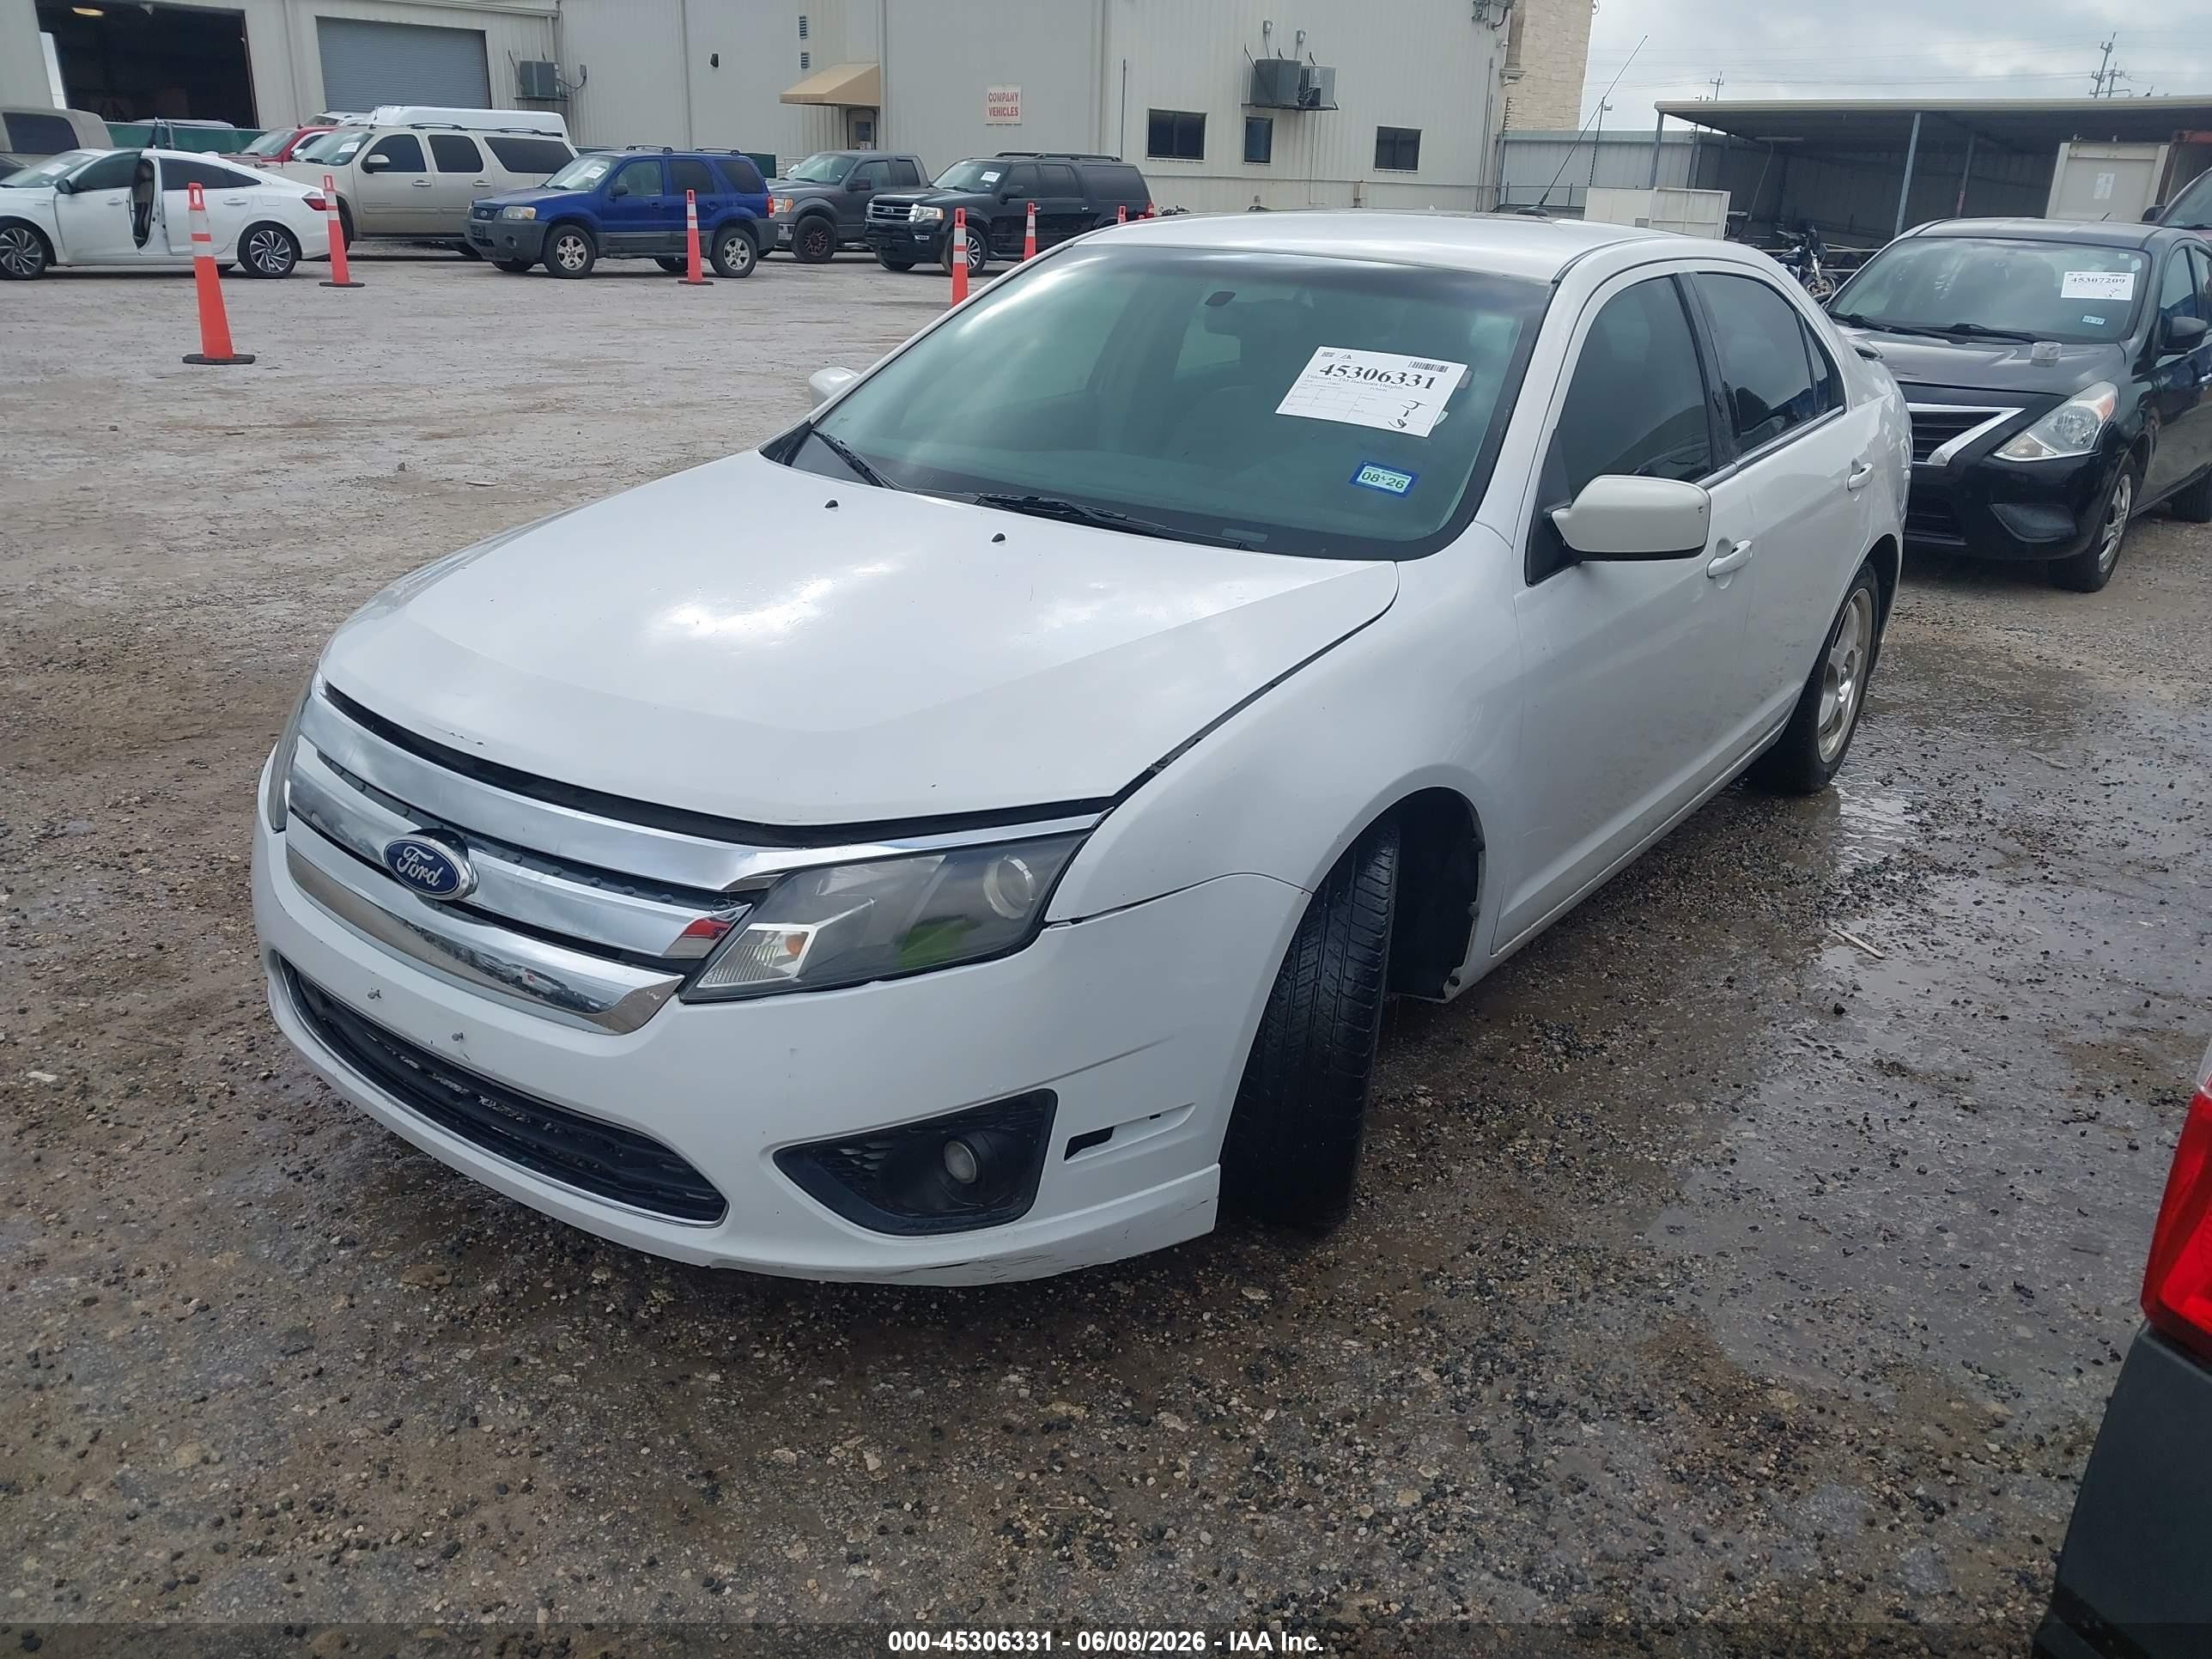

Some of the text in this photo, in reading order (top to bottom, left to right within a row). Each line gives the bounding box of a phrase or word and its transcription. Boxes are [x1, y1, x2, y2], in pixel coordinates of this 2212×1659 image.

[988, 92, 1019, 102] COMPANY
[988, 106, 1019, 117] VEHICLES
[1319, 363, 1437, 391] 45306331
[1361, 471, 1381, 483] 08
[1385, 477, 1406, 489] 26
[397, 846, 444, 887] Ford
